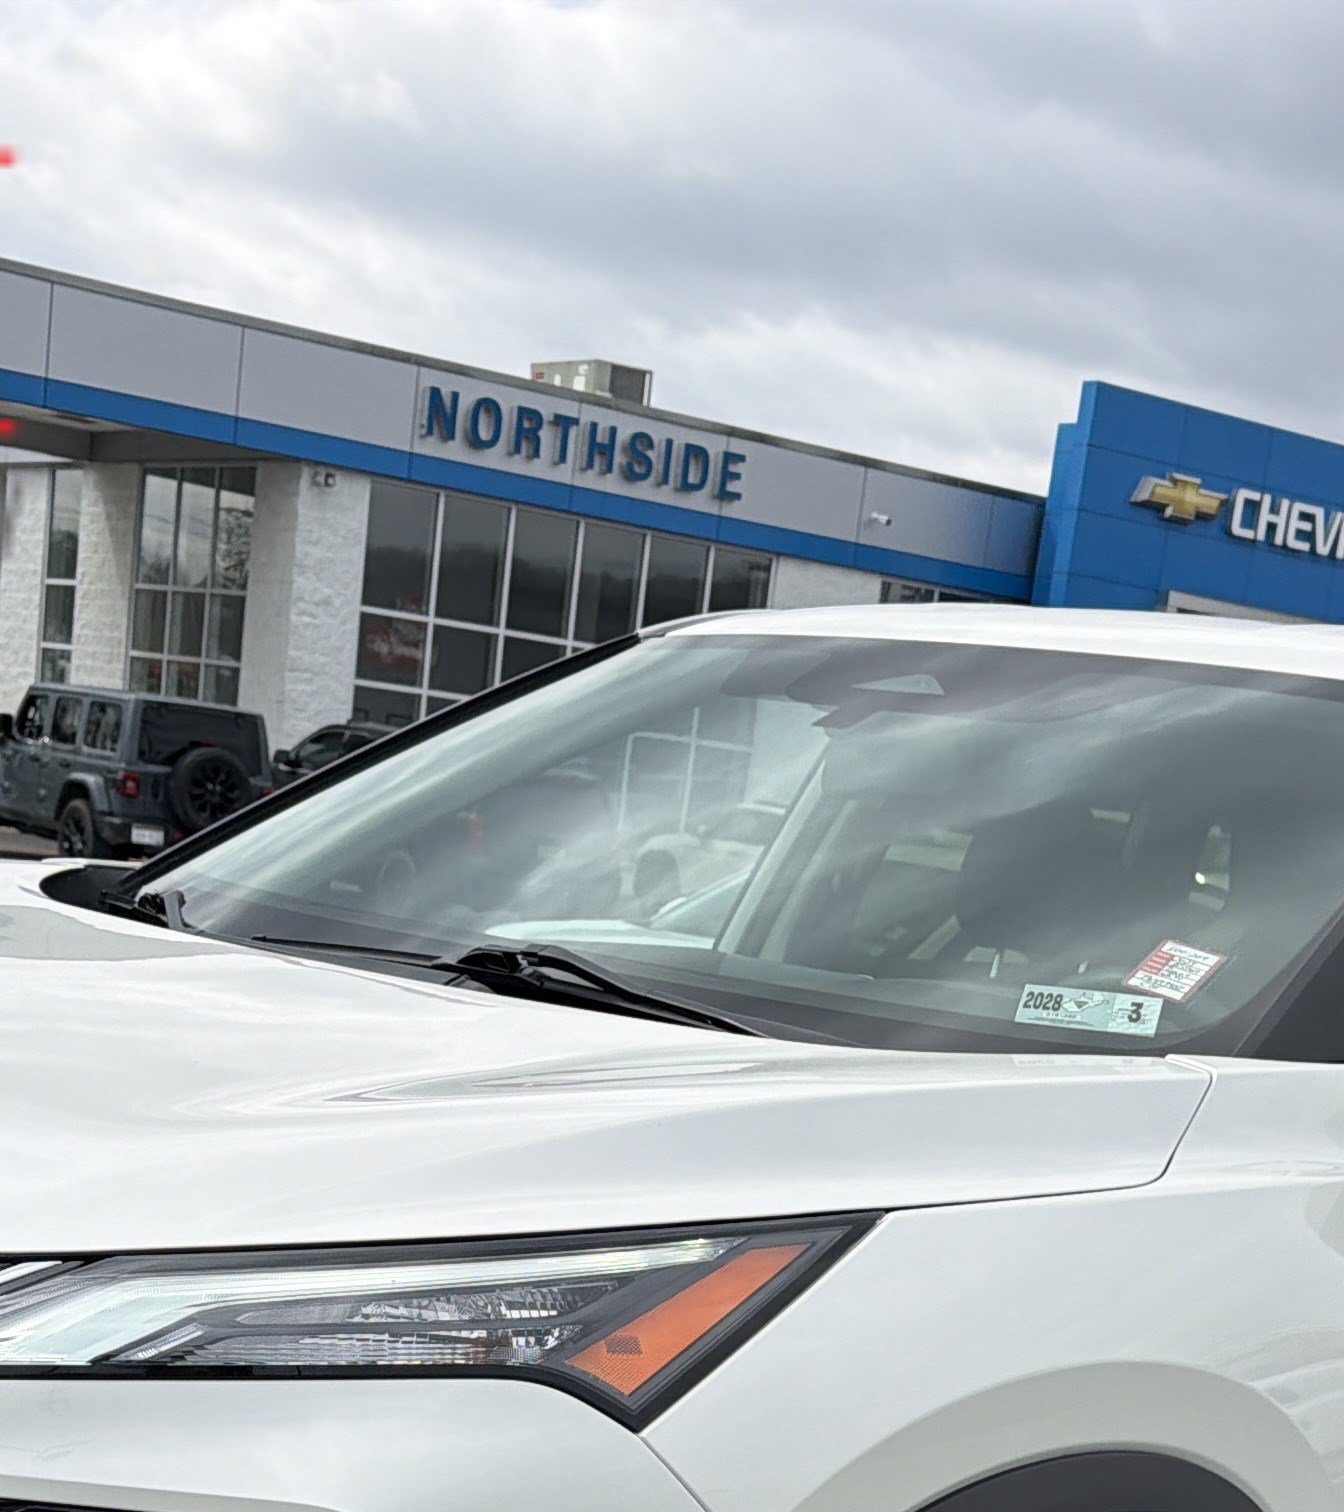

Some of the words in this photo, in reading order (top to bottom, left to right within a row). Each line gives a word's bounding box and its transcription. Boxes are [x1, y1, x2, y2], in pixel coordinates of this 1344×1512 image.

[421, 386, 748, 501] NORTHSIDE
[1022, 990, 1064, 1013] 2028
[1126, 1000, 1145, 1023] 3
